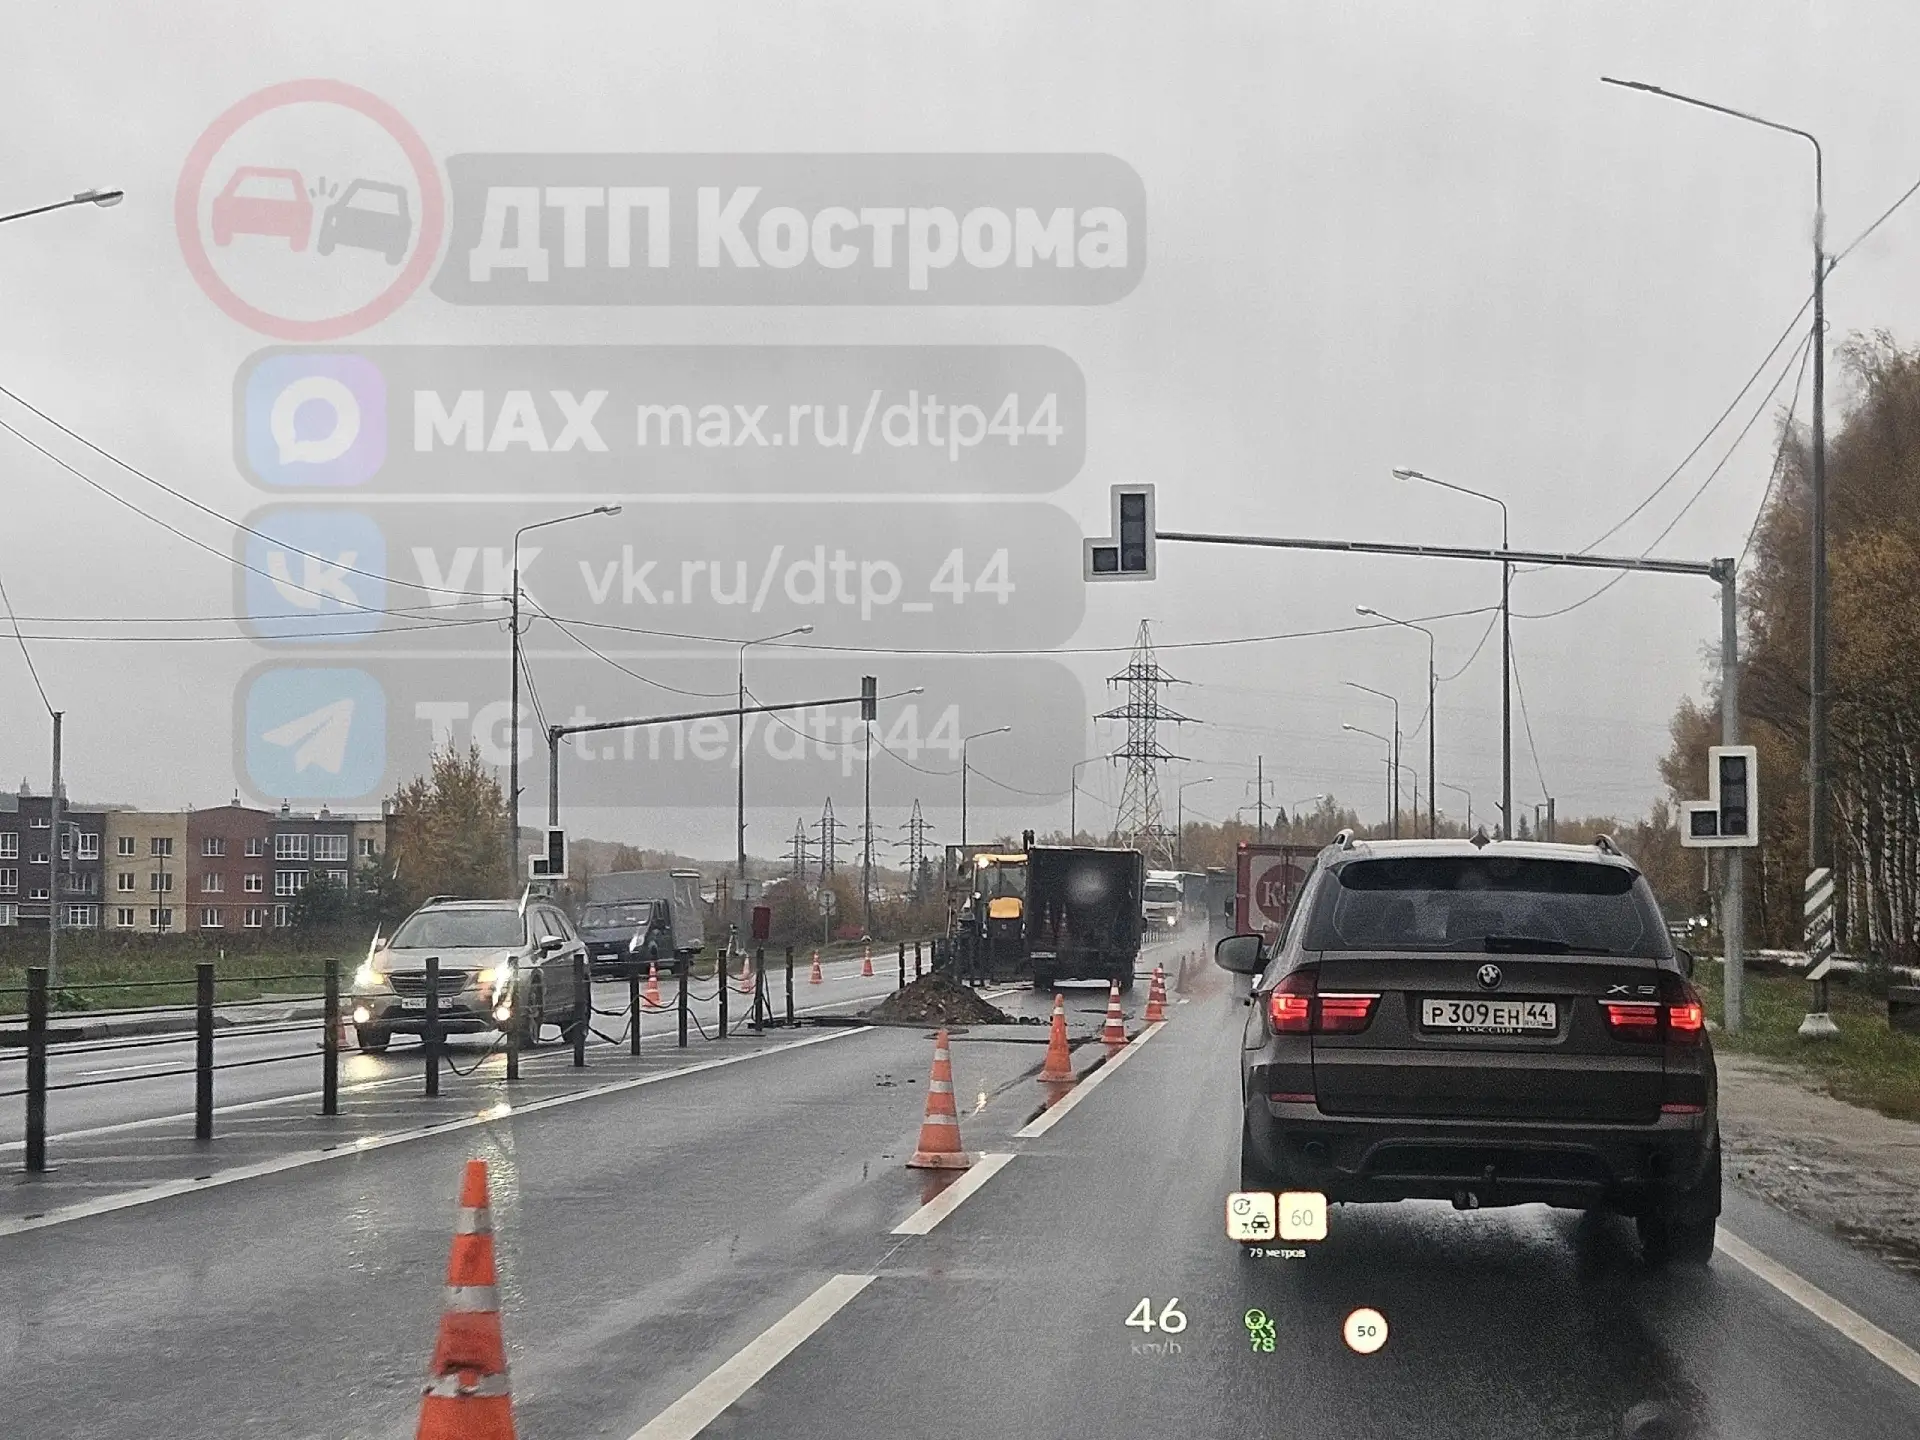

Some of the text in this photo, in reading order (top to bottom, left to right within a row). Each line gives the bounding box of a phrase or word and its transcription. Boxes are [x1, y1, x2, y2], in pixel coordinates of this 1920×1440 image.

[1291, 1209, 1314, 1227] 60
[1249, 1247, 1263, 1258] 79
[1124, 1297, 1188, 1334] 46
[1357, 1325, 1377, 1338] 50
[1250, 1337, 1276, 1352] 78
